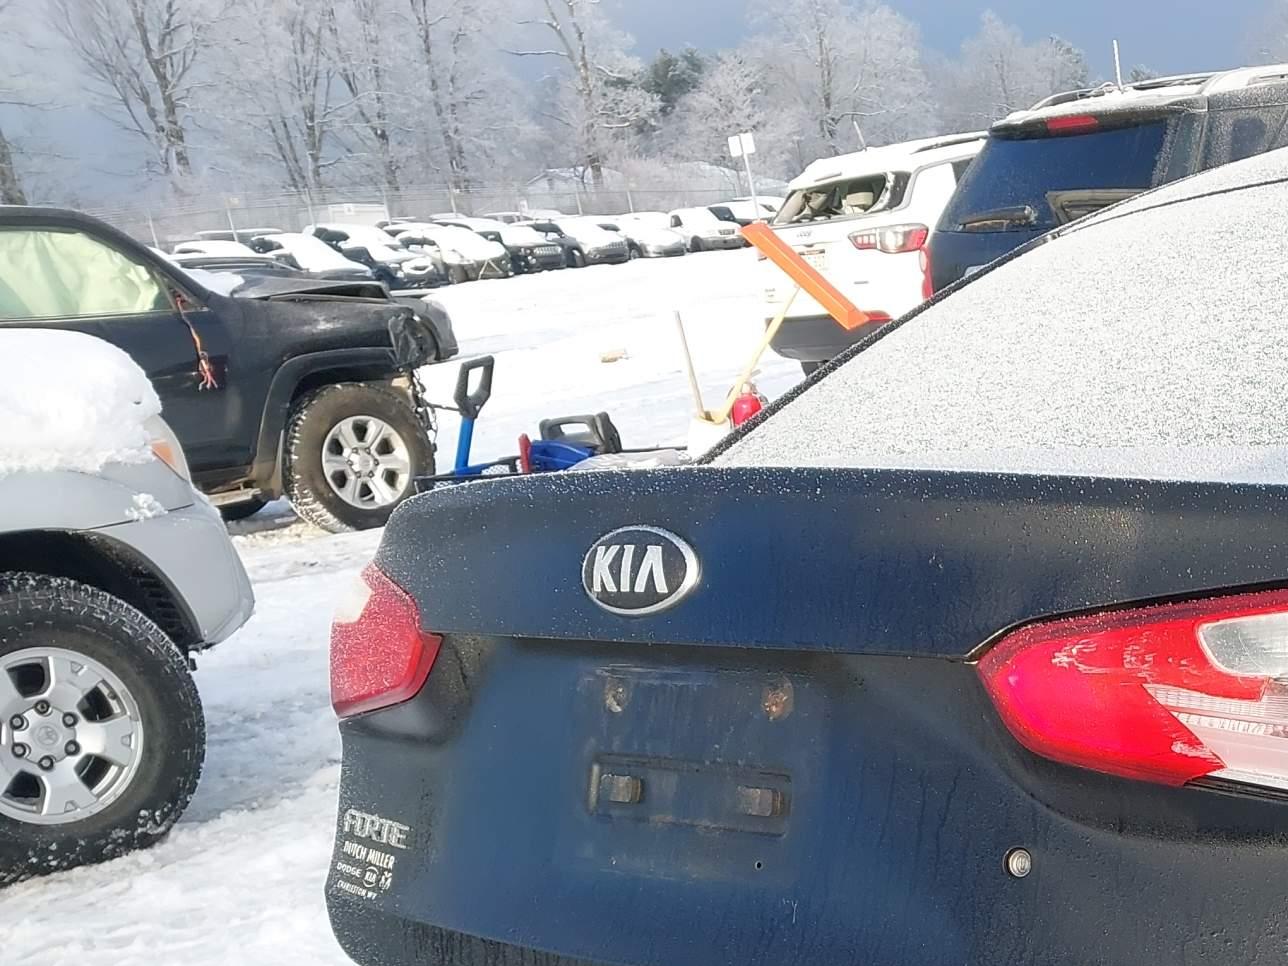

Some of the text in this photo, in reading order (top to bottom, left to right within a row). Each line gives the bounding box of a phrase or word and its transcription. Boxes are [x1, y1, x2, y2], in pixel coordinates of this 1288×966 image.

[593, 544, 669, 594] KIA
[343, 808, 410, 849] FORTE
[366, 849, 395, 870] MILLER
